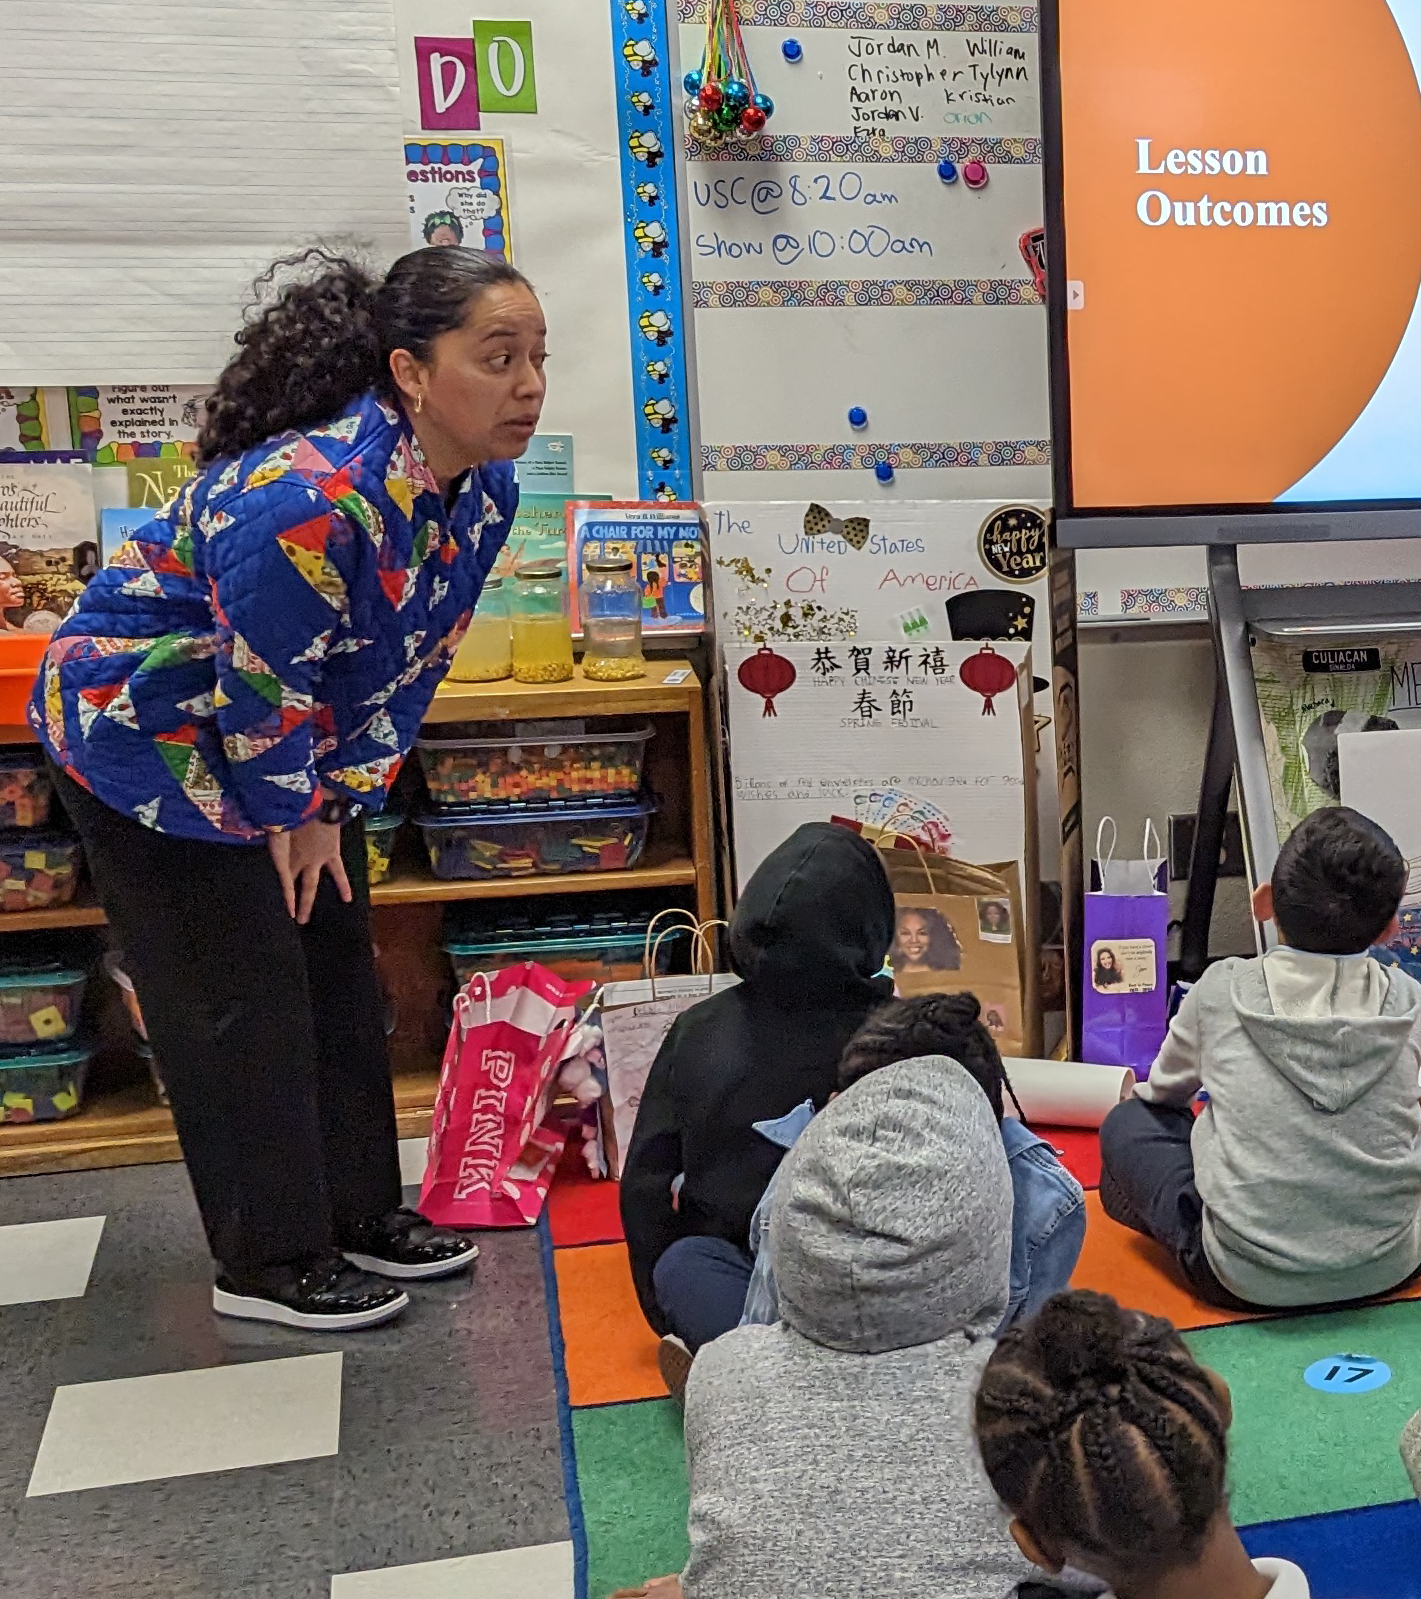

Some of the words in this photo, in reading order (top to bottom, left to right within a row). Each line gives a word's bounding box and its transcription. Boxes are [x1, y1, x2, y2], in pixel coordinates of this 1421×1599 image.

[848, 36, 920, 58] Jordan
[926, 38, 946, 60] M.
[966, 38, 1026, 61] William
[848, 64, 965, 88] Christopher
[969, 64, 1029, 91] Tylynn
[849, 87, 902, 104] Aaron
[851, 106, 905, 122] Jordan
[906, 105, 924, 122] V.
[1135, 138, 1268, 175] Lesson
[1136, 189, 1328, 227] Outcomes
[107, 395, 136, 404] what
[140, 395, 177, 404] wasn't
[110, 418, 165, 429] explained
[169, 418, 178, 427] in
[122, 407, 164, 417] exactly
[117, 430, 136, 438] the
[140, 430, 174, 440] story.
[580, 526, 590, 539] A
[593, 525, 628, 538] CHAIR
[631, 525, 654, 538] FOR
[657, 525, 676, 539] MY
[713, 509, 755, 535] The
[986, 520, 1046, 552] happy
[991, 542, 1010, 554] NEW
[995, 552, 1044, 572] Year
[785, 565, 829, 594] Of
[811, 646, 950, 677] 恭賀新禧
[1312, 651, 1368, 664] CULIACAN
[851, 688, 914, 720] 春節
[453, 1049, 515, 1199] PINK
[1323, 1365, 1375, 1383] 17
